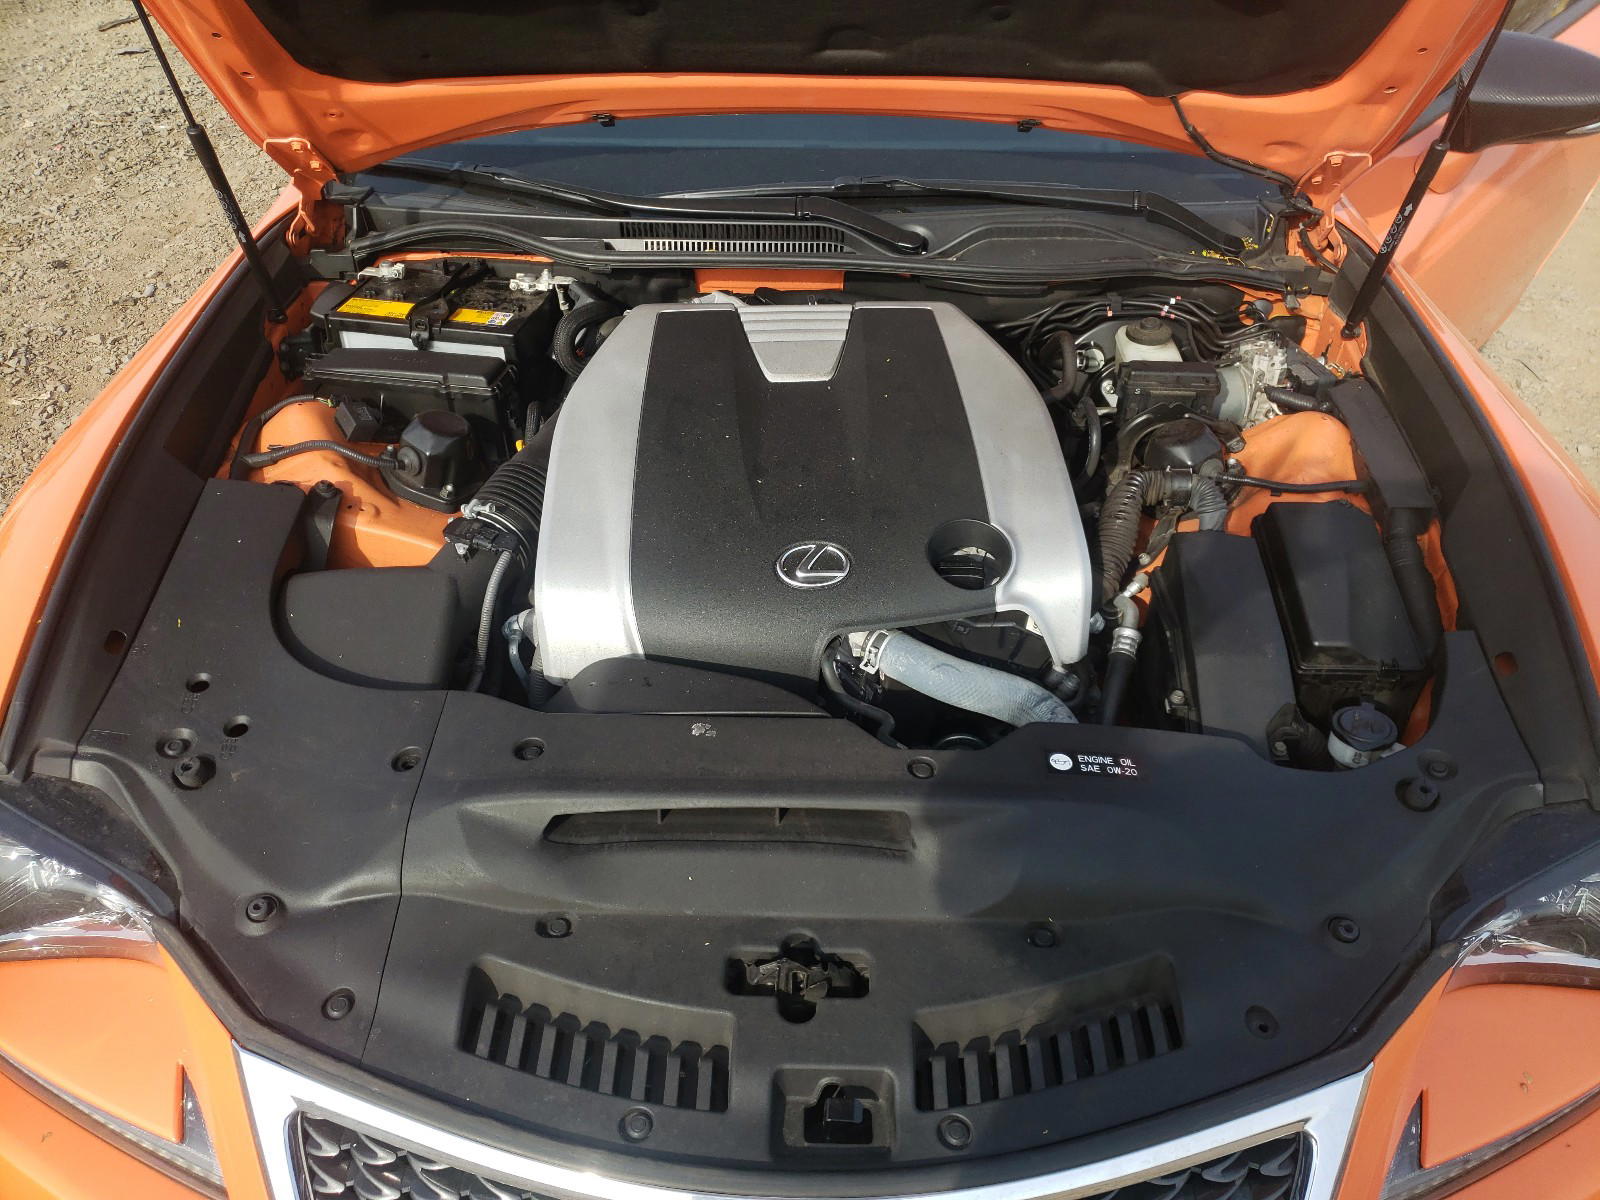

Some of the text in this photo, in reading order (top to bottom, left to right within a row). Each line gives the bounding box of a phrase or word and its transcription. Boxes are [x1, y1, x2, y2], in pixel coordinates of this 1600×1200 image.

[1077, 754, 1137, 767] ENGINE OIL
[1080, 764, 1102, 773] SAE
